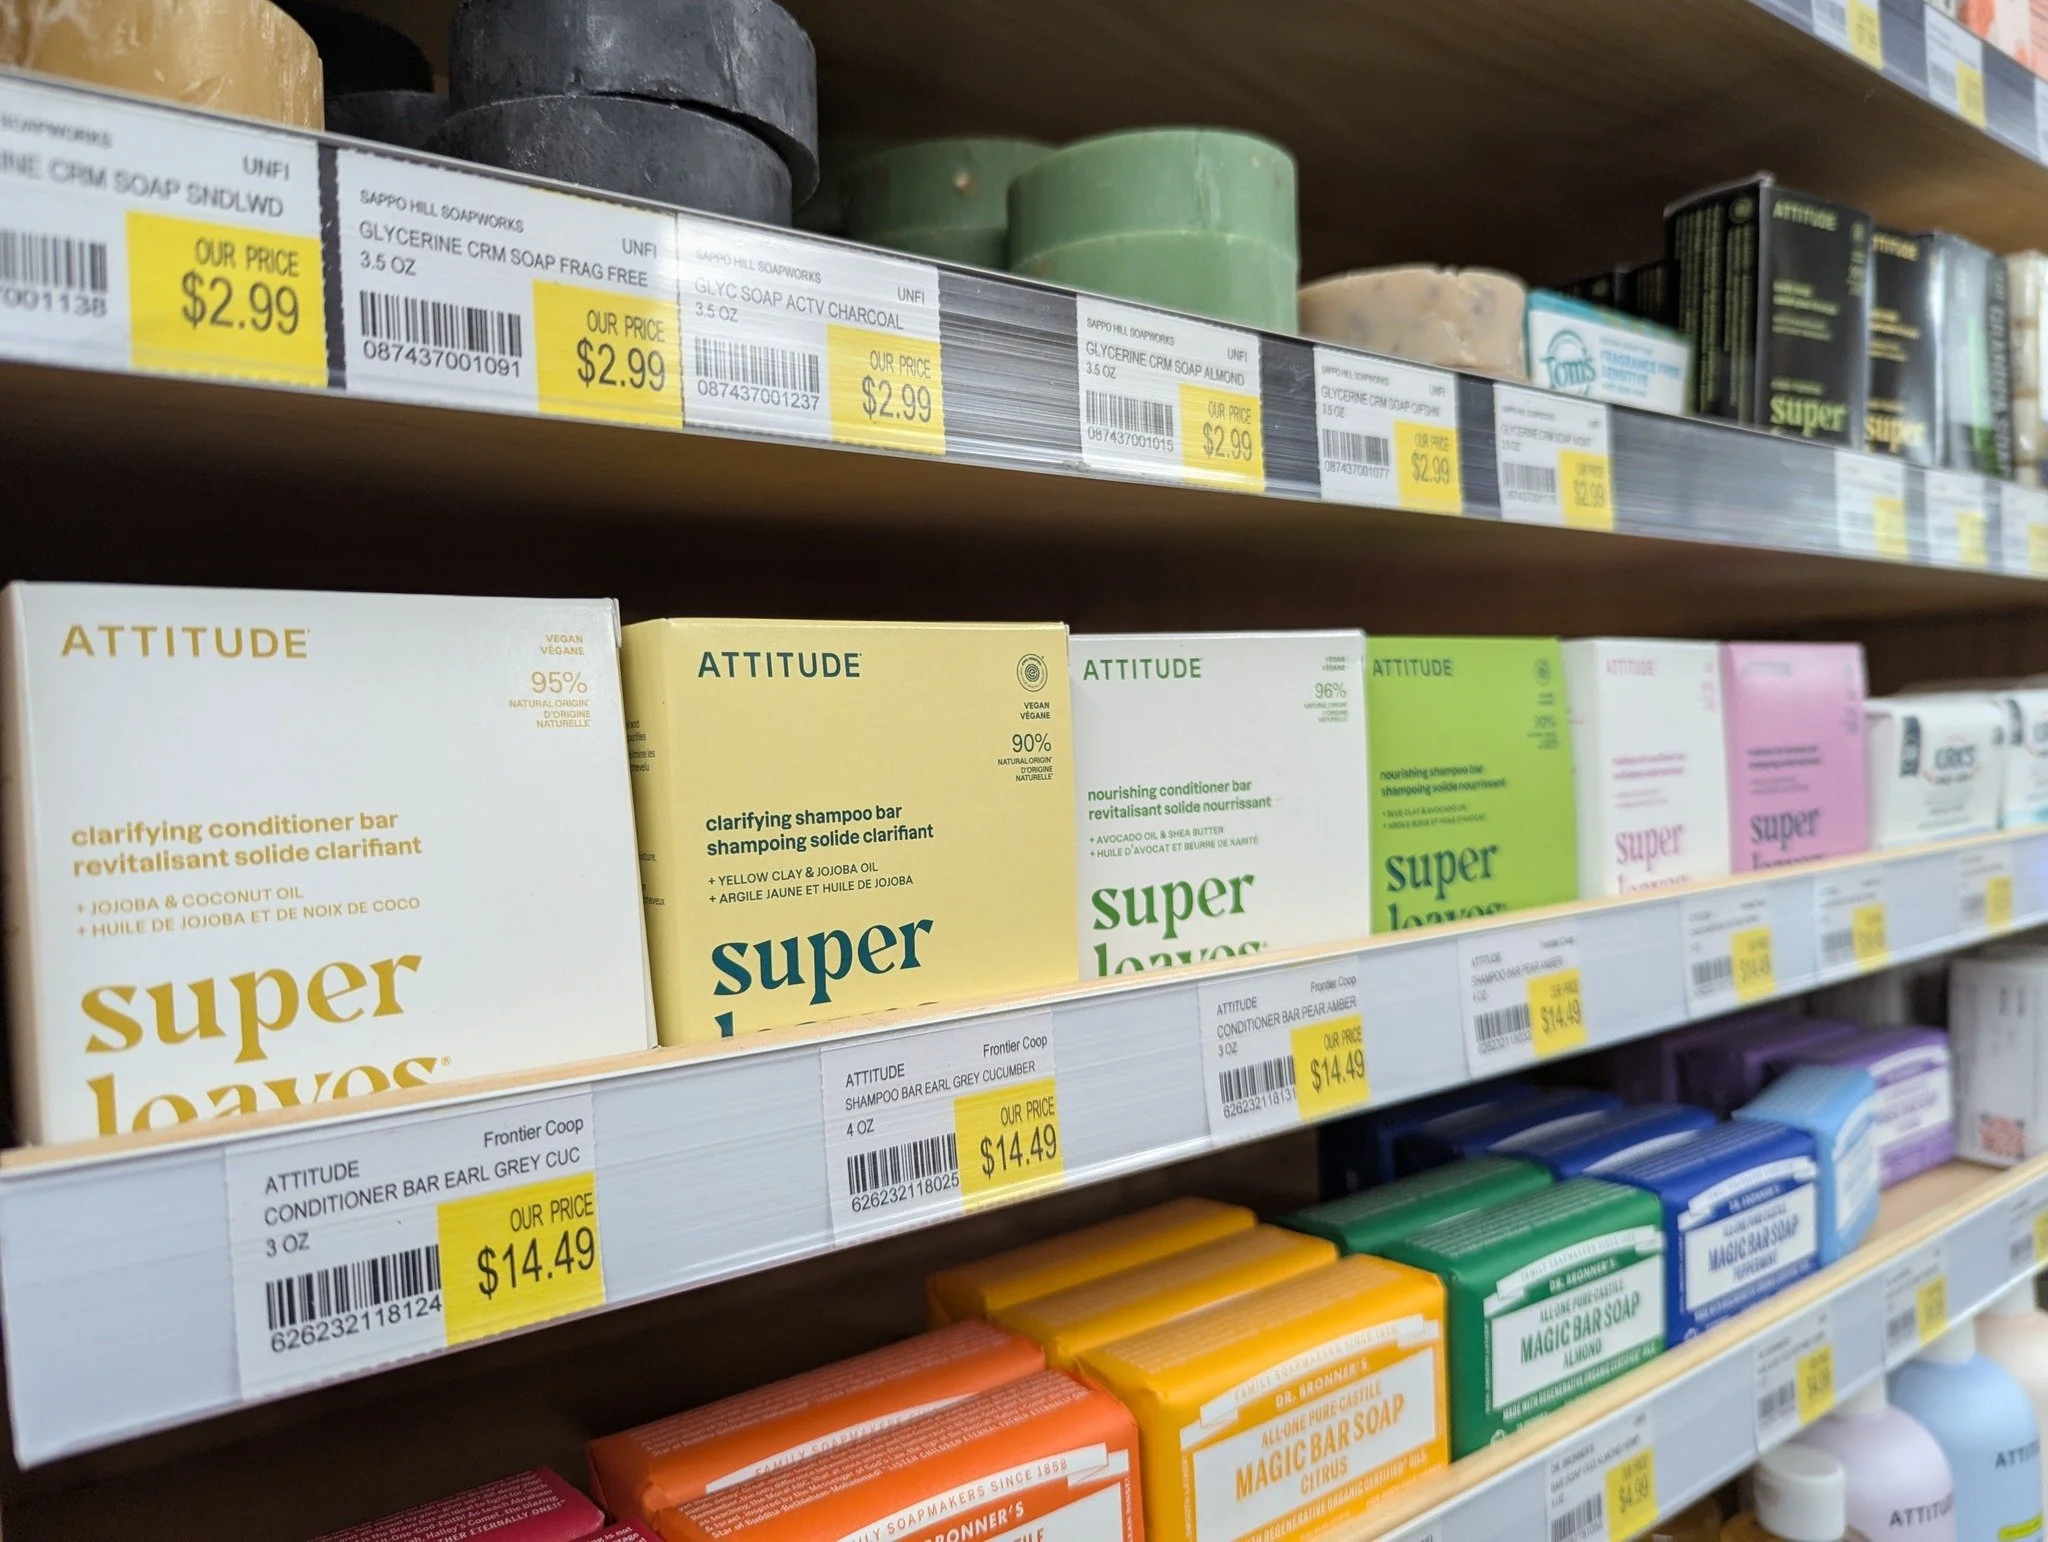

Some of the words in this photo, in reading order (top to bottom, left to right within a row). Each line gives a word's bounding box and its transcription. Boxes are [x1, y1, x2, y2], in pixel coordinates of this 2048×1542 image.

[360, 189, 406, 211] SAPPO
[410, 200, 438, 218] HILL
[441, 205, 524, 233] SOAPWORKS
[195, 237, 236, 269] OUR
[245, 245, 299, 278] PRICE
[360, 220, 462, 255] GLYCERINE
[467, 240, 506, 262] CRM
[511, 248, 555, 270] SOAP
[560, 257, 603, 280] FRAG
[608, 267, 648, 287] FREE
[360, 251, 385, 271] 3.5
[391, 256, 416, 276] OZ
[622, 238, 657, 258] UNFI
[182, 269, 299, 335] $2.99
[695, 277, 737, 299] GLYC
[741, 286, 782, 306] SOAP
[786, 295, 824, 314] ACTV
[828, 302, 904, 330] CHARCOAL
[695, 302, 715, 318] 3.5
[719, 306, 738, 322] OZ
[897, 287, 925, 305] UNFI
[587, 309, 617, 335] OUR
[625, 315, 665, 342] PRICE
[363, 340, 521, 379] 087437001091
[577, 337, 665, 392] $2.99
[870, 350, 893, 371] OUR
[899, 355, 931, 379] PRICE
[1086, 341, 1146, 367] GLYCERINE
[1149, 356, 1172, 371] CRM
[1174, 360, 1201, 376] SOAP
[1204, 366, 1245, 387] ALMOND
[1086, 362, 1100, 375] 3.5
[1103, 366, 1116, 379] OZ
[698, 379, 820, 411] 087437001237
[862, 375, 931, 423] $2.99
[1208, 401, 1225, 418] OUR
[1229, 405, 1251, 425] PRICE
[1770, 393, 1847, 438] super
[1088, 427, 1173, 452] 087437001015
[1203, 421, 1252, 462] $2.99
[1411, 451, 1449, 484] $2.99
[61, 624, 309, 659] ATTITUDE
[540, 645, 584, 655] VÉGANE
[545, 634, 583, 643] VEGAN
[697, 652, 860, 678] ATTITUDE
[1083, 658, 1202, 681] ATTITUDE
[1372, 659, 1453, 677] ATTITUDE
[531, 671, 587, 693] 95%
[1314, 682, 1347, 700] 96%
[544, 711, 591, 719] D'ORIGINE
[1020, 711, 1050, 719] VÉGANE
[1012, 733, 1052, 752] 90%
[1380, 767, 1428, 781] nourishing
[1430, 766, 1468, 776] shampoo
[1469, 764, 1483, 775] bar
[1087, 784, 1157, 802] nourishing
[1160, 780, 1230, 797] conditioner
[1233, 780, 1252, 792] bar
[706, 811, 793, 832] clarifying
[795, 806, 872, 828] shampoo
[875, 805, 902, 820] bar
[1088, 804, 1162, 820] revitalisant
[1164, 801, 1201, 815] solide
[1203, 796, 1272, 811] nourrissant
[71, 821, 202, 848] clarifying
[209, 812, 355, 840] conditioner
[359, 810, 398, 830] bar
[707, 835, 807, 857] shampoing
[810, 829, 860, 847] solide
[863, 824, 933, 843] clarifiant
[1750, 808, 1820, 851] super
[72, 848, 229, 878] revitalisant
[235, 843, 310, 867] solide
[315, 836, 422, 861] clarifiant
[1615, 823, 1684, 871] super
[718, 870, 768, 886] YELLOW
[771, 867, 802, 881] CLAY
[805, 866, 814, 878] &
[817, 864, 857, 879] JOJOBA
[860, 862, 878, 873] OIL
[1385, 844, 1499, 900] super
[719, 889, 763, 904] ARGILE
[766, 886, 803, 899] JAUNE
[806, 884, 819, 895] ET
[823, 881, 854, 894] HUILE
[857, 879, 872, 890] DE
[874, 875, 913, 889] JOJOBA
[1091, 874, 1255, 940] super
[710, 919, 933, 1006] super
[1310, 979, 1337, 993] Frontier
[1338, 975, 1356, 988] Coop
[81, 954, 423, 1065] super
[1216, 996, 1258, 1016] ATTITUDE
[1217, 1012, 1281, 1038] CONDITIONER
[1282, 1008, 1300, 1023] BAR
[1302, 1003, 1325, 1020] PEAR
[1326, 995, 1357, 1013] AMBER
[1540, 998, 1582, 1035] $14.49
[983, 1039, 1019, 1057] Frontier
[1022, 1034, 1047, 1050] Coop
[1218, 1045, 1224, 1057] 3
[1225, 1042, 1237, 1055] OZ
[1324, 1032, 1339, 1050] OUR
[1342, 1026, 1362, 1046] PRICE
[845, 1063, 905, 1088] ATTITUDE
[845, 1088, 898, 1111] SHAMPOO
[902, 1083, 922, 1099] BAR
[925, 1076, 951, 1094] EARL
[954, 1072, 980, 1088] GREY
[982, 1061, 1035, 1082] CUCUMBER
[1310, 1049, 1365, 1093] $14.49
[1001, 1104, 1022, 1126] OUR
[1026, 1096, 1055, 1120] PRICE
[1223, 1087, 1297, 1118] 626232118131
[484, 1125, 542, 1149] Frontier
[545, 1118, 584, 1138] Coop
[846, 1123, 854, 1137] 4
[857, 1119, 874, 1134] OZ
[981, 1124, 1056, 1179] $14.49
[264, 1160, 360, 1194] ATTITUDE
[264, 1183, 396, 1226] CONDITIONER
[403, 1176, 438, 1198] BAR
[445, 1167, 489, 1189] EARL
[495, 1155, 542, 1179] GREY
[546, 1147, 580, 1168] CUC
[851, 1172, 960, 1212] 626232118025
[510, 1204, 542, 1232] OUR
[550, 1192, 593, 1223] PRICE
[266, 1238, 278, 1257] 3
[282, 1232, 310, 1252] OZ
[1709, 1236, 1746, 1273] MAGIC
[1748, 1225, 1769, 1255] BAR
[1771, 1213, 1799, 1245] SOAP
[478, 1227, 596, 1299] $14.49
[272, 1294, 442, 1354] 626232118124
[1521, 1319, 1570, 1364] MAGIC
[1573, 1307, 1601, 1341] BAR
[1604, 1291, 1640, 1328] SOAP
[1563, 1338, 1602, 1368] ALMOND
[1276, 1391, 1296, 1409] DR.
[1300, 1356, 1368, 1397] BRONNER'S
[1235, 1439, 1306, 1500] MAGIC
[1310, 1419, 1349, 1464] BAR
[1354, 1393, 1405, 1441] SOAP
[1300, 1455, 1348, 1495] CITRUS
[887, 1485, 986, 1535] SOAPMAKERS
[990, 1472, 1032, 1492] SINCE
[1037, 1460, 1068, 1477] 1858
[469, 1510, 530, 1537] ETERNALLY
